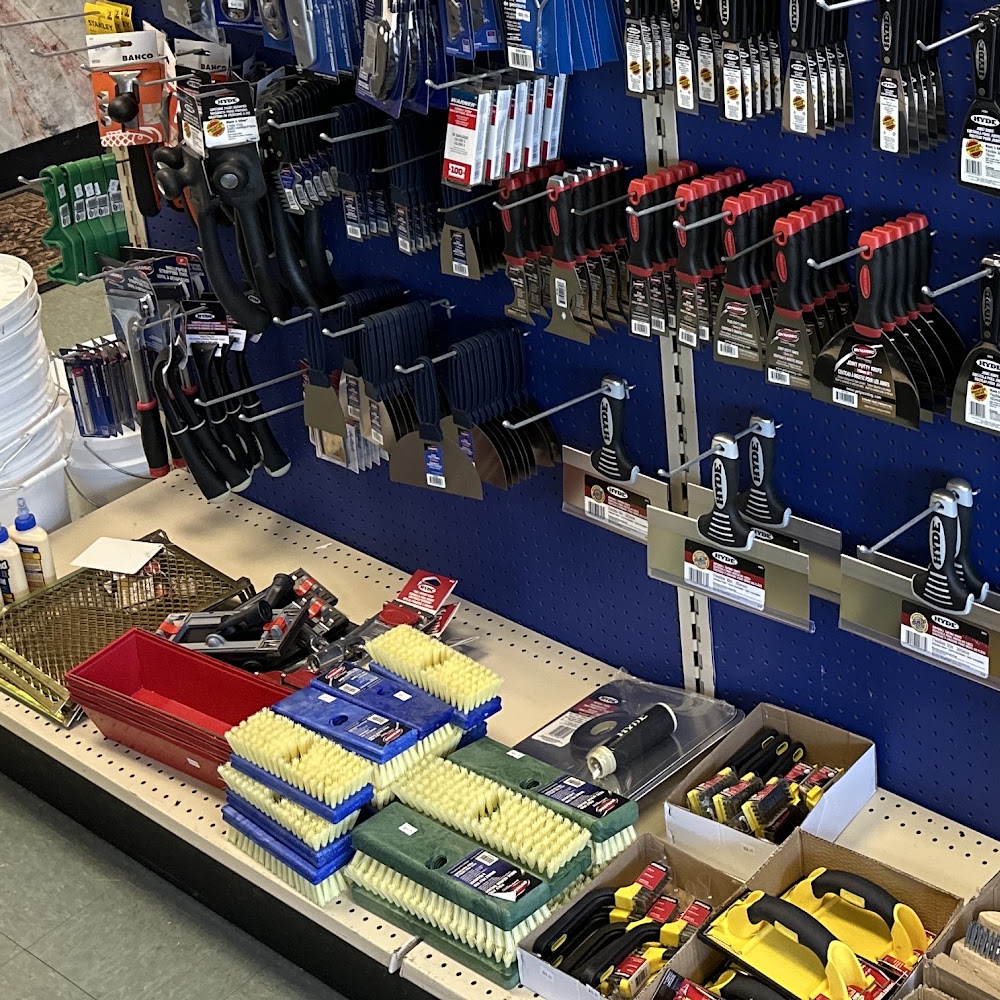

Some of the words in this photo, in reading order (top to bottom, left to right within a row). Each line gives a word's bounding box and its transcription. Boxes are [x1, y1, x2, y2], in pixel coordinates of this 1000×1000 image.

[88, 20, 114, 31] STANLEY
[883, 14, 891, 49] HYDE
[122, 53, 154, 62] BAHCO
[972, 115, 998, 126] HYDE
[602, 401, 610, 441] HYDE
[752, 441, 760, 483] HYDE
[714, 462, 724, 506] HYDE
[932, 521, 942, 566] HYDE
[714, 553, 736, 564] HYDE
[934, 616, 957, 628] HYDE
